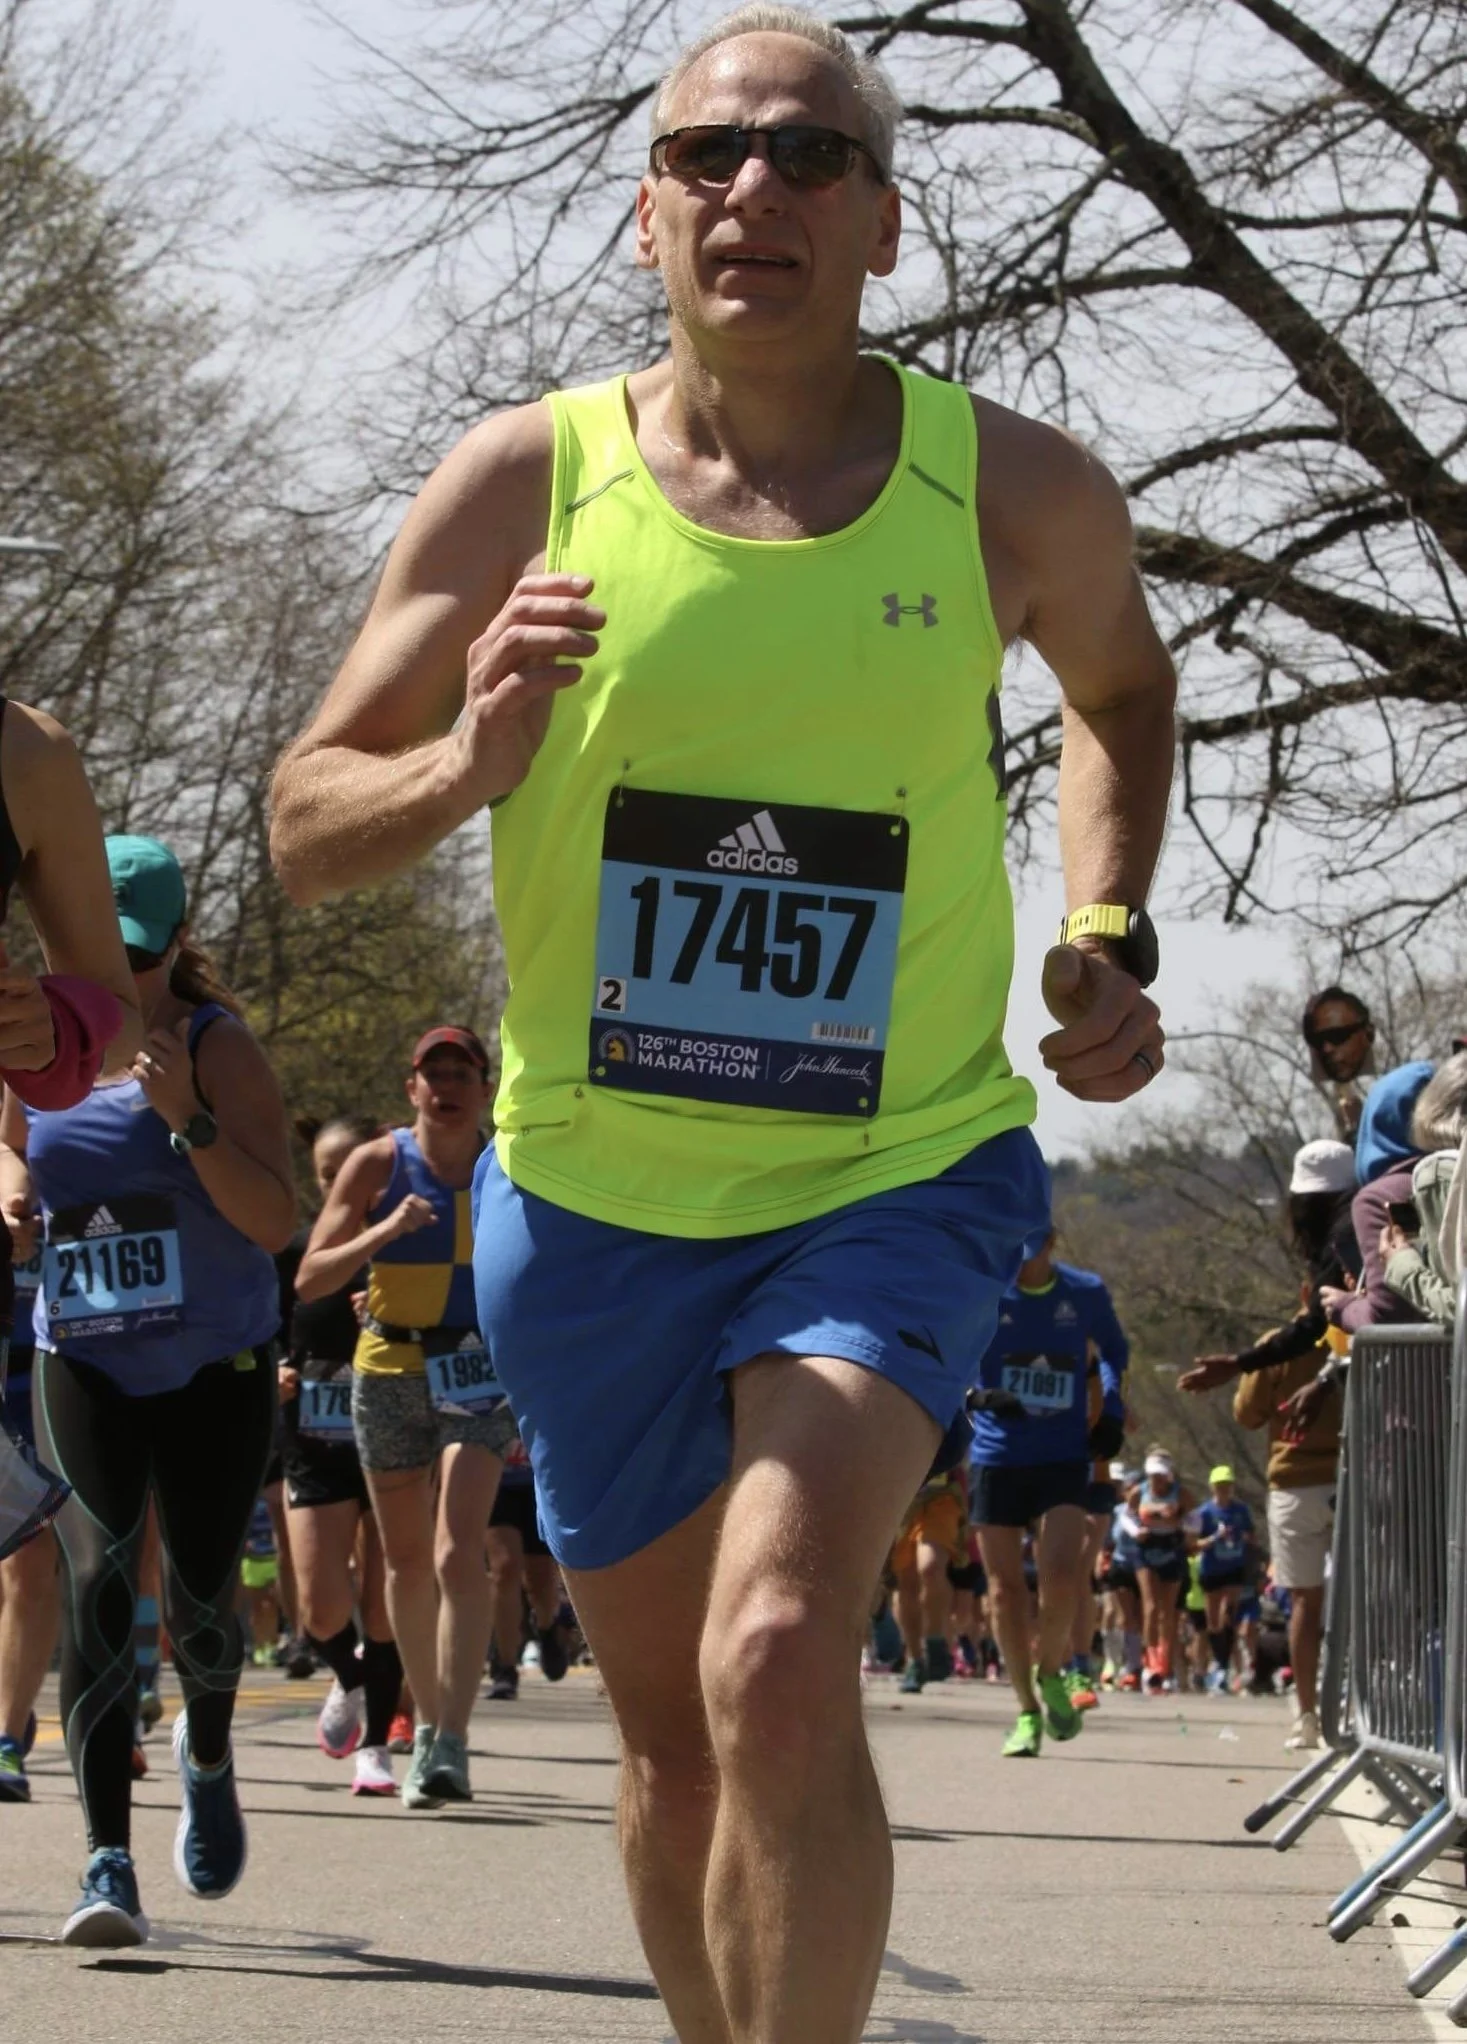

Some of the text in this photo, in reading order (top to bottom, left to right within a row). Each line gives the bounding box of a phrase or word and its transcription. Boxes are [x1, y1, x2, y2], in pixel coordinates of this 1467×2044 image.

[707, 848, 799, 876] adidas
[631, 876, 877, 1000] 17457
[600, 979, 622, 1011] 2
[637, 1033, 678, 1051] 126TH
[680, 1040, 759, 1062] BOSTON
[638, 1051, 758, 1080] MARATHON
[57, 1236, 167, 1298] 21169
